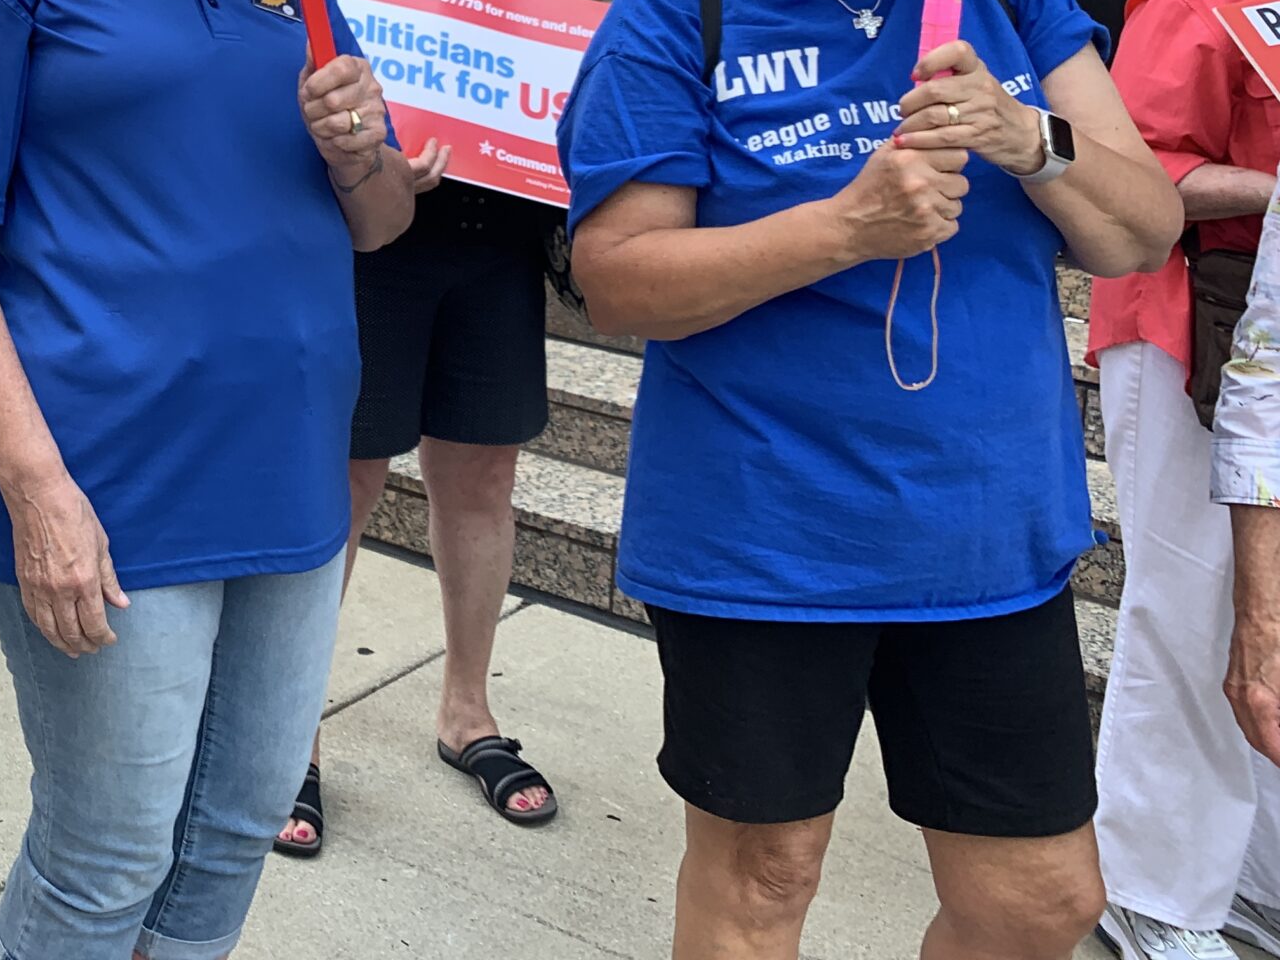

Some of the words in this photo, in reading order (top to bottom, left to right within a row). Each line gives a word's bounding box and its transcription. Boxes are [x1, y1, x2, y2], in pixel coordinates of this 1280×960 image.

[485, 3, 504, 18] for
[505, 11, 540, 27] news
[541, 19, 567, 33] and
[345, 14, 515, 79] oliticians
[456, 70, 509, 109] for
[715, 47, 820, 102] LWV
[735, 112, 831, 152] eague
[839, 103, 860, 126] of
[495, 148, 557, 175] Common
[772, 139, 853, 165] Making
